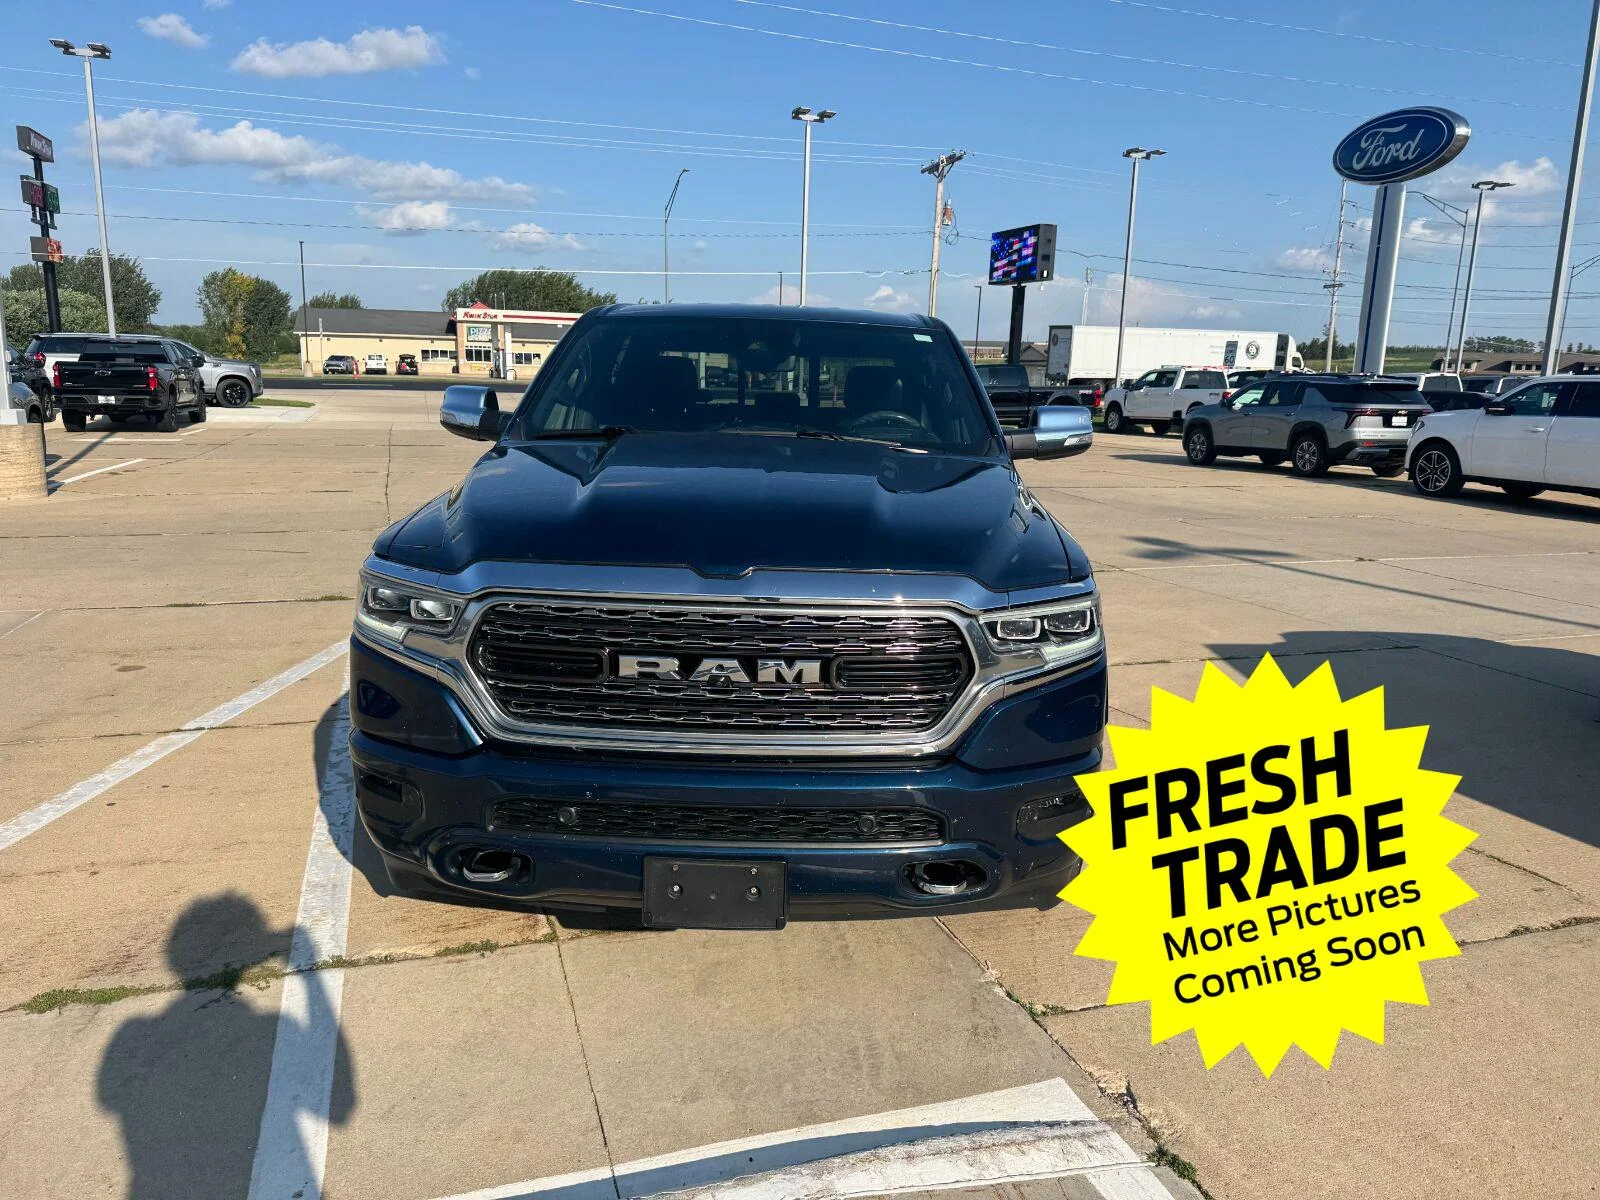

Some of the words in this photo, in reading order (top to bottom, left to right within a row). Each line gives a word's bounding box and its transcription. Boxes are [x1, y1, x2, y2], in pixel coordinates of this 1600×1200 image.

[1352, 123, 1425, 171] Ford
[1224, 355, 1235, 363] 60
[618, 654, 822, 683] RAM
